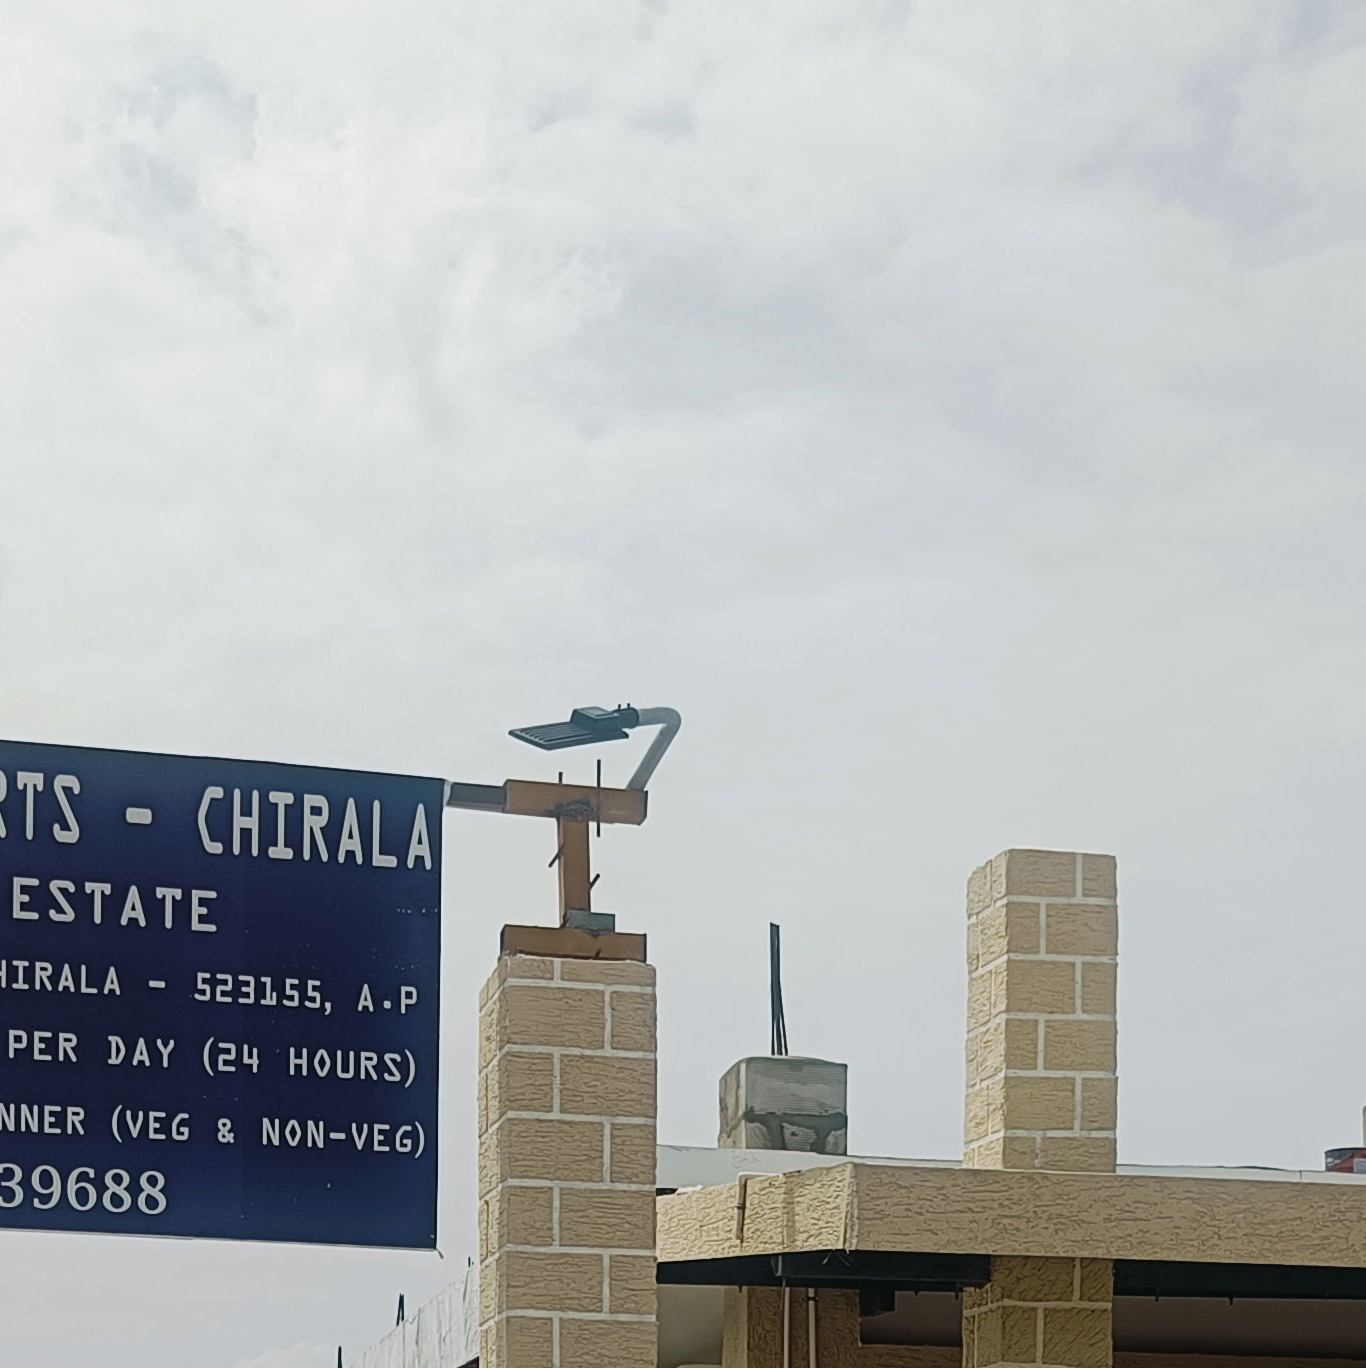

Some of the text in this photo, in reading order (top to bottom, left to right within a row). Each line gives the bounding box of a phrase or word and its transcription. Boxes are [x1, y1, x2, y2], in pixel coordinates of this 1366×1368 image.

[198, 787, 431, 870] CHIRALA
[13, 877, 217, 931] ESTATE
[195, 973, 331, 1015] 523155,
[358, 984, 417, 1013] A.P
[9, 1030, 77, 1062] PER
[108, 1036, 174, 1067] DAY
[204, 1037, 259, 1076] (24
[290, 1047, 415, 1087] HOURS)
[112, 1105, 189, 1142] (VEG
[263, 1118, 424, 1158] NON-VEG)
